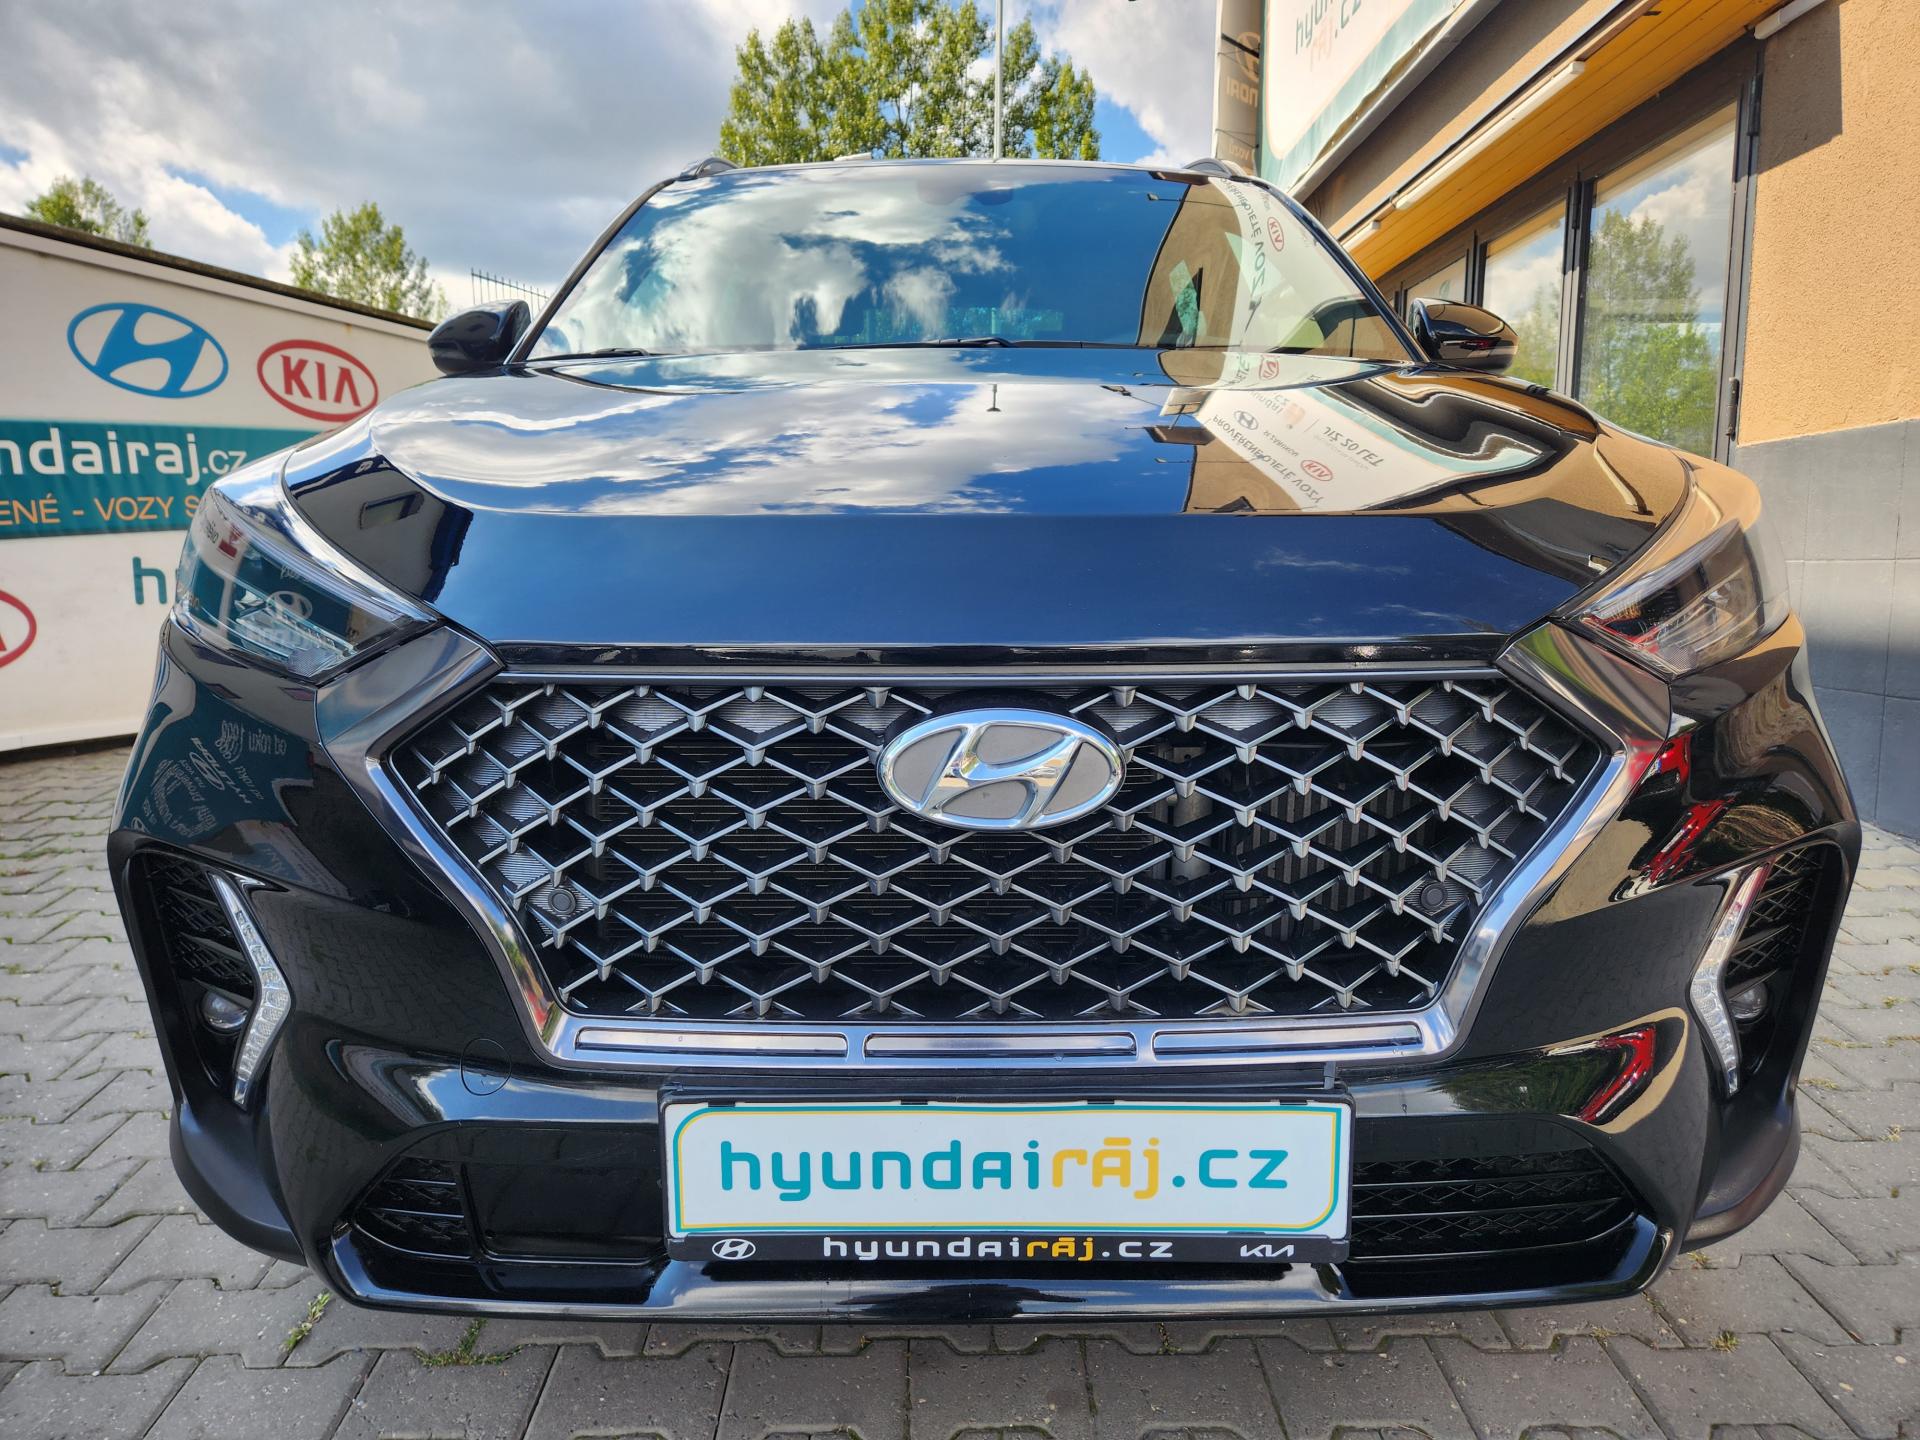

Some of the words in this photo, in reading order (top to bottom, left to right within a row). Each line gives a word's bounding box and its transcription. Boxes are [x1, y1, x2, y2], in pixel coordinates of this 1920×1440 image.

[281, 355, 361, 408] KIA
[95, 496, 174, 521] VOZY
[1240, 1243, 1294, 1258] KIA
